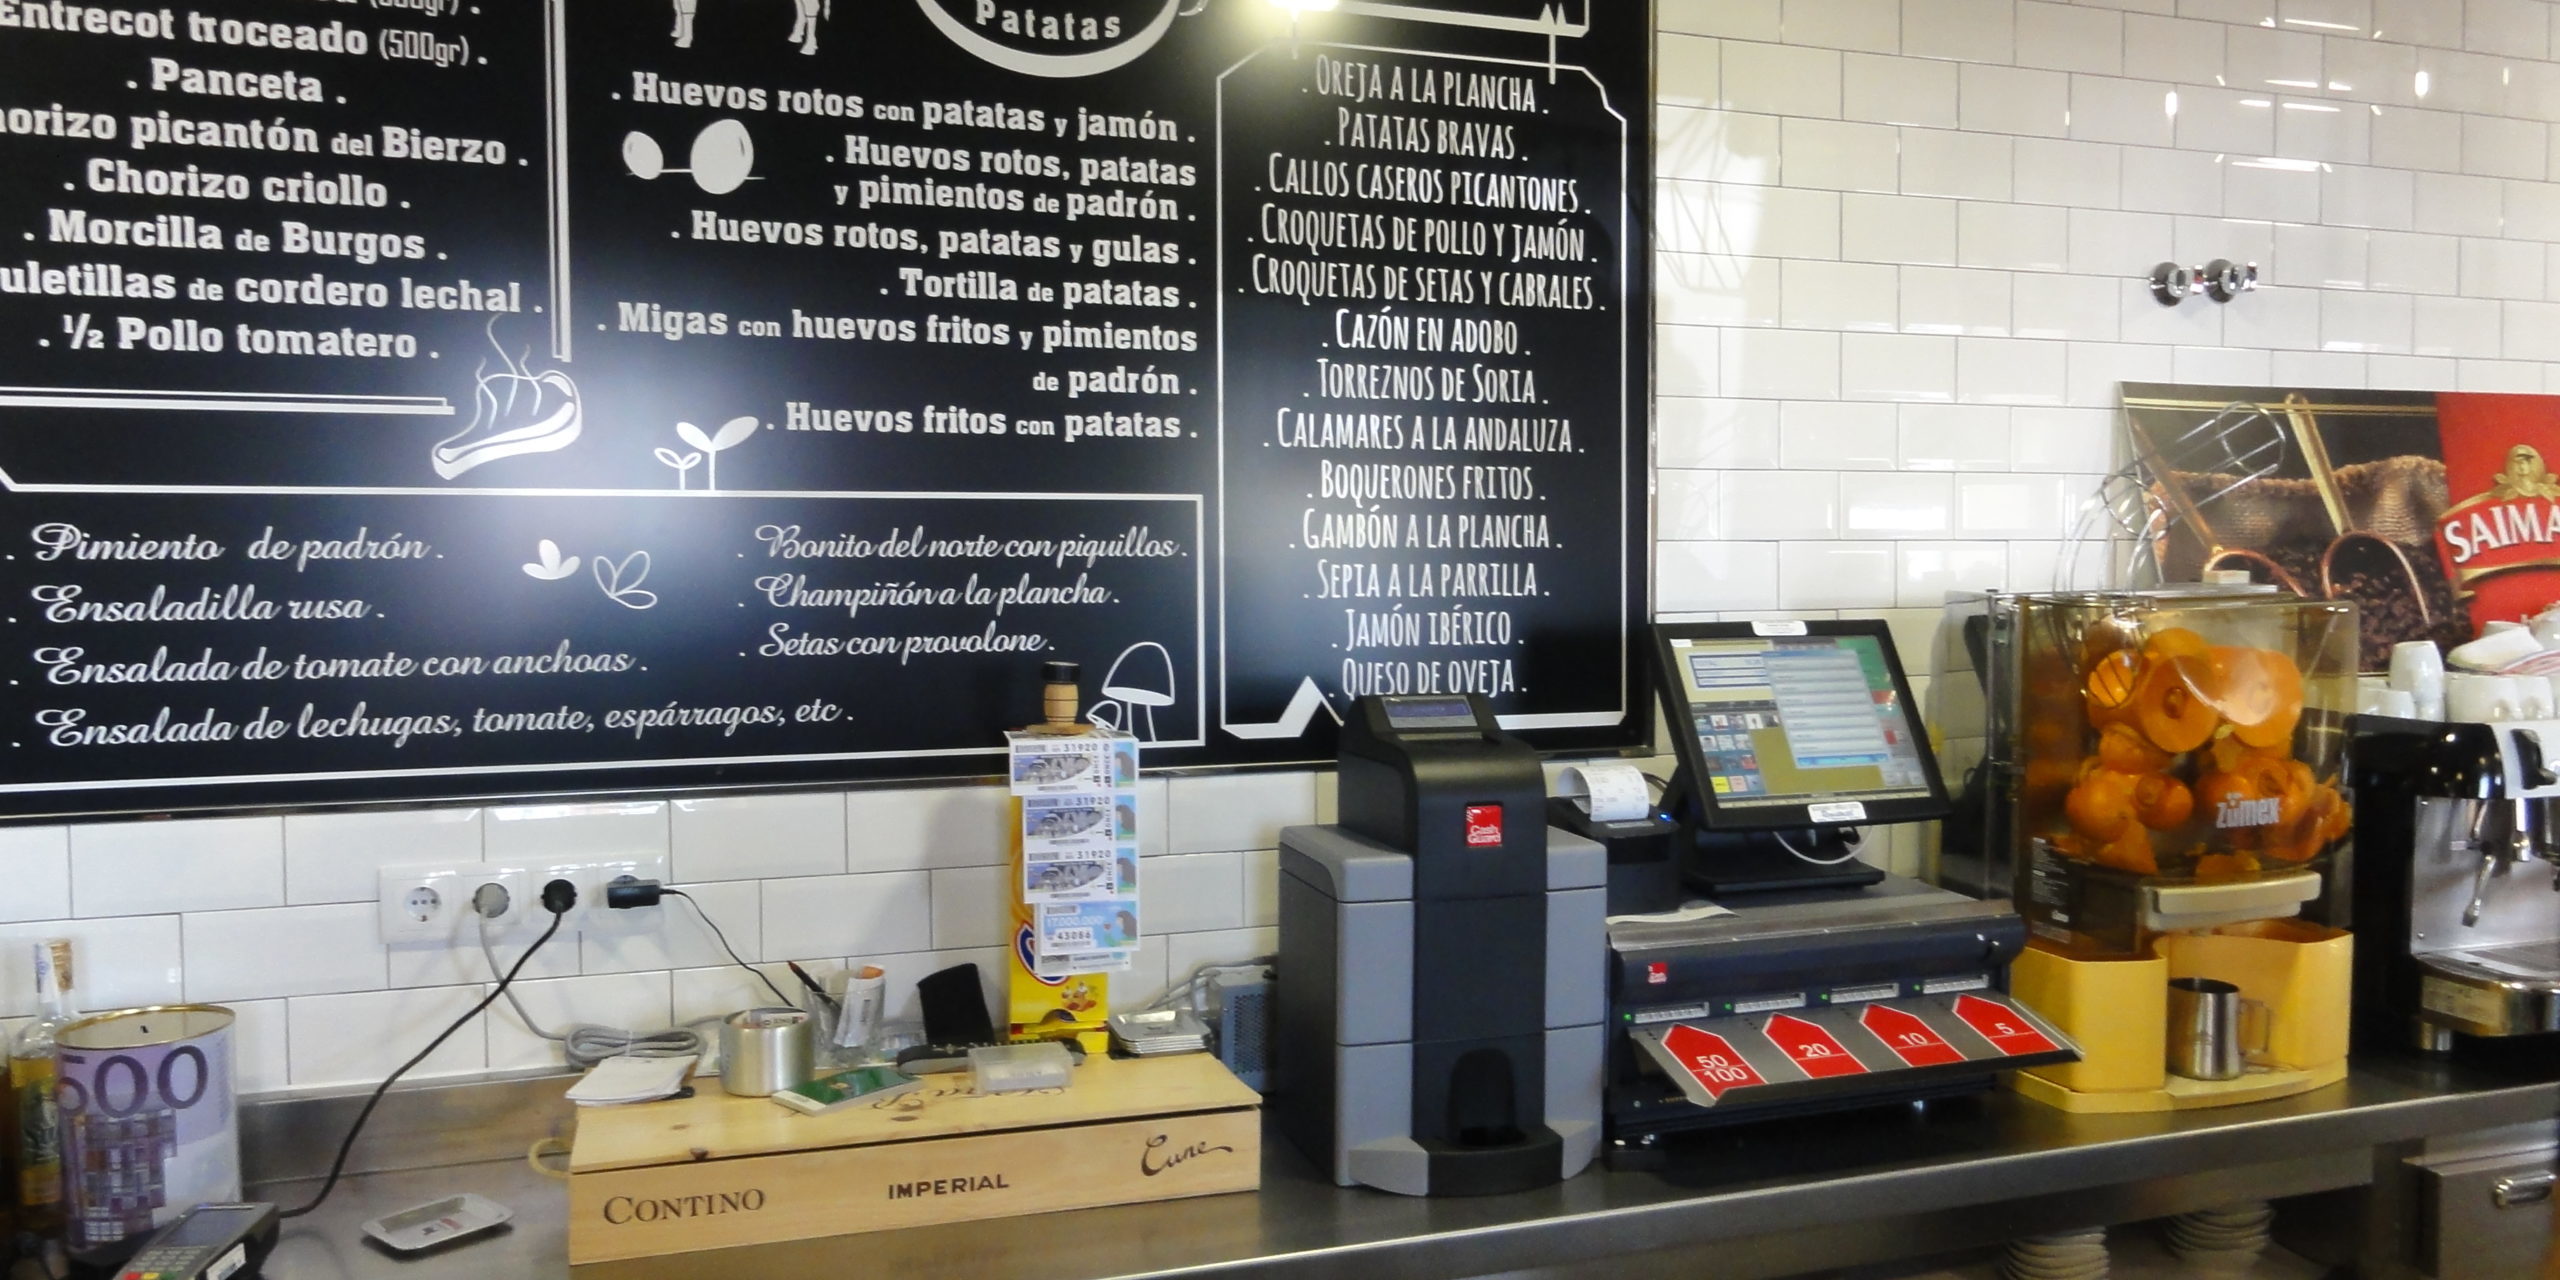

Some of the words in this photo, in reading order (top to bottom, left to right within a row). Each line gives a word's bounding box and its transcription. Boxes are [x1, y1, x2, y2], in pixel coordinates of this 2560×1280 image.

[0, 0, 174, 39] Entrecot
[188, 12, 367, 54] troceado
[379, 29, 469, 67] (500gr)
[976, 0, 1120, 40] Patatas
[151, 58, 323, 102] Panceta
[1316, 54, 1382, 102] OREJA
[1390, 66, 1403, 100] A
[1412, 68, 1436, 103] LA
[1444, 71, 1535, 112] PLANCHA
[632, 71, 767, 110] Huevos
[778, 89, 863, 117] rotos
[874, 104, 915, 121] con
[923, 100, 1045, 131] patatas
[1054, 118, 1067, 137] y
[1078, 107, 1177, 141] jamón
[131, 112, 319, 152] picantón
[331, 133, 373, 156] del
[382, 126, 505, 164] Bierzo
[1339, 107, 1430, 153] PATATAS
[1438, 120, 1514, 159] BRAVAS
[88, 158, 249, 199] Chorizo
[263, 172, 387, 207] criollo
[845, 135, 970, 171] Huevos
[981, 149, 1069, 180] rotos,
[1080, 157, 1196, 186] patatas
[1269, 152, 1349, 197] CALLOS
[1357, 164, 1443, 203] CASEROS
[1451, 171, 1578, 213] PICANTONES
[834, 185, 848, 205] y
[859, 175, 1024, 211] pimientos
[1034, 193, 1059, 213] de
[1067, 190, 1178, 221] padrón
[48, 209, 223, 249] Morcilla
[236, 229, 270, 251] de
[282, 221, 425, 264] Burgos
[692, 210, 823, 245] Huevos
[834, 223, 928, 253] rotos,
[939, 229, 1060, 259] patatas
[1069, 244, 1083, 263] y
[1093, 235, 1179, 267] gulas
[1262, 203, 1385, 255] CROQUETAS
[1393, 217, 1417, 251] DE
[1425, 219, 1485, 255] POLLO
[1493, 224, 1504, 256] Y
[1512, 218, 1584, 263] JAMÓN
[189, 278, 223, 301] de
[236, 274, 388, 307] cordero
[401, 277, 520, 312] lechal
[899, 268, 1018, 300] Tortilla
[1028, 283, 1053, 302] de
[1063, 280, 1179, 309] patatas
[1253, 253, 1376, 305] CROQUETAS
[1384, 266, 1408, 300] DE
[1416, 267, 1473, 303] SETAS
[1481, 272, 1492, 304] Y
[1500, 272, 1592, 309] CABRALES
[118, 317, 223, 352] Pollo
[237, 324, 416, 358] tomatero
[618, 302, 728, 340] Migas
[738, 321, 781, 337] con
[792, 309, 916, 341] huevos
[927, 315, 1010, 345] fritos
[1019, 331, 1033, 350] y
[1043, 320, 1197, 353] pimientos
[1336, 306, 1409, 350] CAZÓN
[1417, 317, 1443, 351] EN
[1451, 319, 1517, 354] ADOBO
[1033, 372, 1058, 391] de
[1069, 365, 1179, 398] padrón
[1317, 358, 1434, 400] TORREZNOS
[1442, 368, 1465, 401] DE
[1473, 363, 1535, 403] SORIA
[786, 402, 913, 432] Huevos
[924, 405, 1006, 434] fritos
[1016, 420, 1055, 435] con
[1065, 412, 1180, 442] patatas
[1278, 407, 1403, 449] CALAMARES
[1411, 416, 1424, 449] A
[1433, 417, 1457, 450] LA
[1464, 417, 1571, 452] ANDALUZA
[1322, 460, 1455, 508] BOQUERONES
[1463, 466, 1532, 500] FRITOS
[32, 523, 225, 561] Pimiento
[248, 526, 296, 559] de
[298, 527, 430, 572] padrón
[755, 525, 878, 559] Bonito
[878, 526, 927, 557] del
[928, 535, 1003, 557] norte
[1005, 540, 1057, 557] con
[1057, 526, 1176, 568] piquillos
[1303, 504, 1397, 549] GAMBÓN
[1406, 514, 1419, 547] A
[1427, 515, 1451, 548] LA
[1459, 515, 1549, 548] PLANCHA
[755, 573, 938, 618] Champiñón
[939, 588, 961, 605] a
[965, 573, 997, 604] la
[997, 573, 1111, 616] plancha
[1318, 559, 1380, 598] SEPIA
[1388, 564, 1401, 597] A
[1409, 564, 1433, 597] LA
[1441, 563, 1536, 597] PARRILLA
[31, 584, 281, 623] Ensaladilla
[288, 600, 370, 619] rusa
[759, 623, 845, 656] Setas
[847, 637, 901, 654] con
[902, 620, 1046, 665] provolone
[1345, 604, 1419, 651] JAMÓN
[1428, 604, 1510, 645] IBÉRICO
[34, 646, 239, 684] Ensalada
[242, 647, 289, 679] de
[295, 652, 418, 679] tomate
[423, 657, 488, 676] con
[493, 639, 634, 674] anchoas
[1343, 658, 1409, 701] QUESO
[1418, 662, 1441, 694] DE
[1449, 659, 1514, 698] OVEJA
[35, 707, 239, 746] Ensalada
[244, 707, 290, 739] de
[795, 699, 842, 722] etc
[1797, 1043, 1832, 1058] 20
[1896, 1032, 1929, 1047] 10
[1997, 1022, 2015, 1036] 5
[56, 1045, 208, 1116] 500
[1695, 1055, 1730, 1070] 50
[1703, 1067, 1748, 1082] 100
[603, 1188, 765, 1226] CONTINO
[888, 1173, 1009, 1200] IMPERIAL
